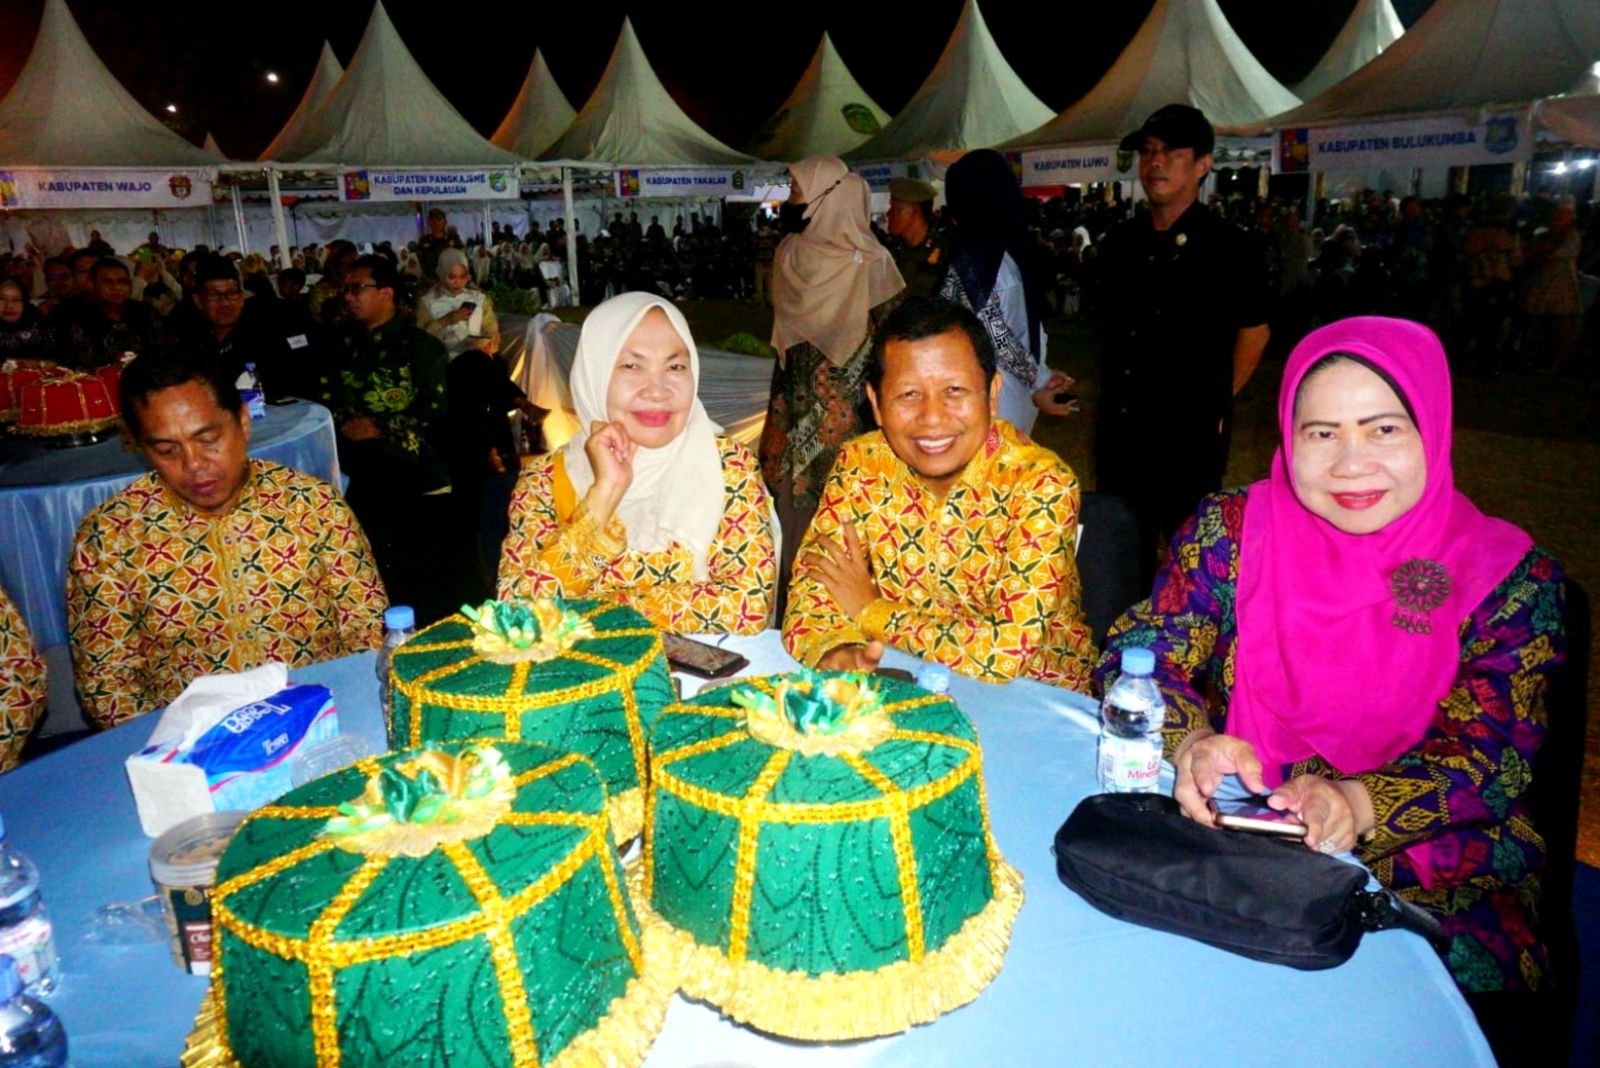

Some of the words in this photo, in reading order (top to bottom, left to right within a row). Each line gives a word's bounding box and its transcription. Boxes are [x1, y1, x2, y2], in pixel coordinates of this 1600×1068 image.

[1318, 137, 1389, 153] KABUPATEN
[1391, 130, 1477, 149] BULUKUMBA
[1033, 159, 1080, 172] KABUPATEN
[1082, 156, 1109, 168] LUWU
[373, 174, 428, 185] KABUPATEN
[645, 176, 692, 186] KABUPATEN
[693, 176, 728, 185] TAKALAR
[38, 181, 114, 192] KABUPATEN
[116, 181, 152, 192] WAJO
[393, 186, 413, 195] DAN
[415, 185, 467, 195] KEPULAUAN
